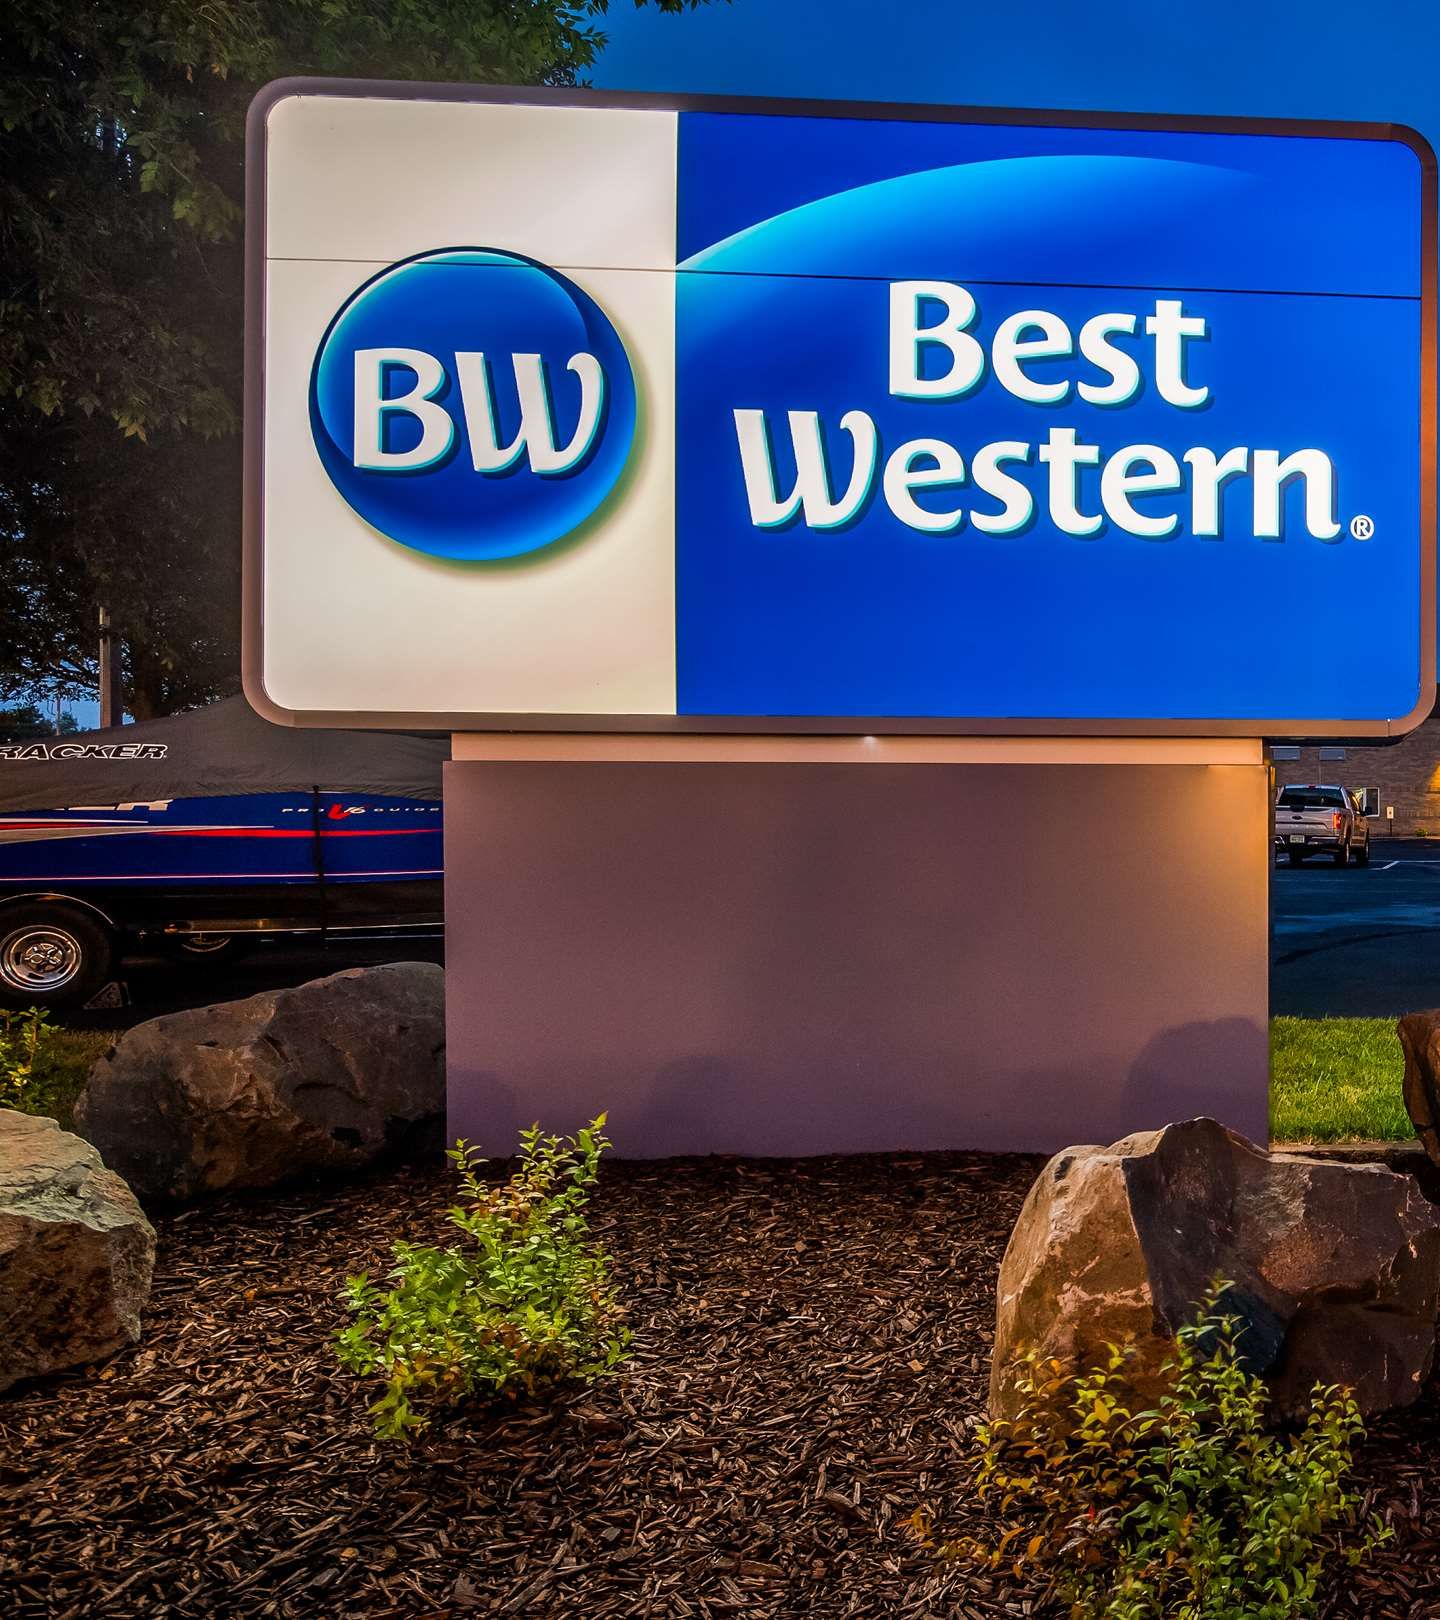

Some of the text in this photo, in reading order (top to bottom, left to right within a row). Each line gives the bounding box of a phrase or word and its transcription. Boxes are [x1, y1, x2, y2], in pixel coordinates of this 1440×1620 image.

[889, 280, 1209, 408] Best
[353, 347, 605, 474] BW
[733, 409, 1342, 540] Western
